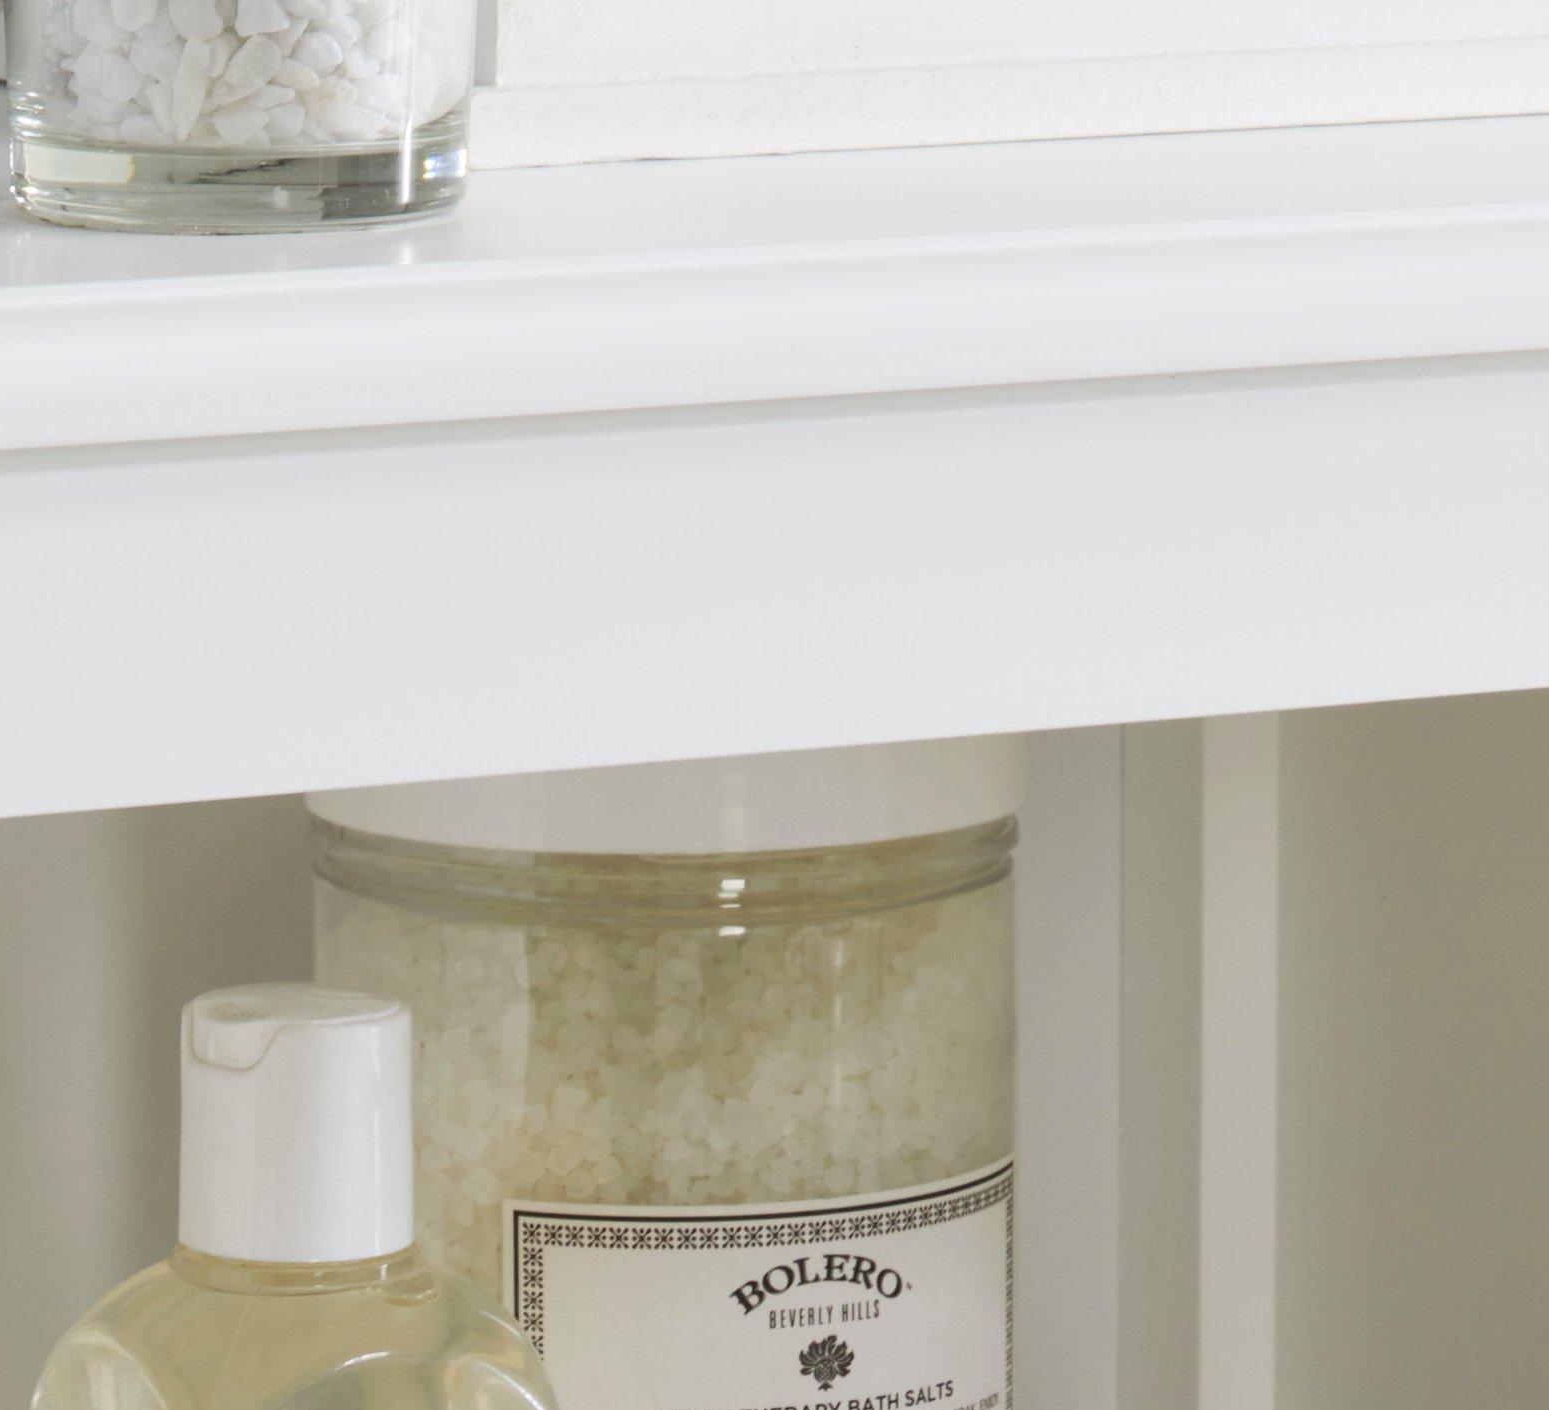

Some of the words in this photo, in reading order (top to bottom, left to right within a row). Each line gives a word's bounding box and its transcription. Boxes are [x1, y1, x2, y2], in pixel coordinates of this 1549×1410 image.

[729, 1254, 903, 1316] BOLERO
[769, 1305, 833, 1329] BEVERLY
[841, 1299, 881, 1322] HILLS
[905, 1380, 954, 1408] SALTS
